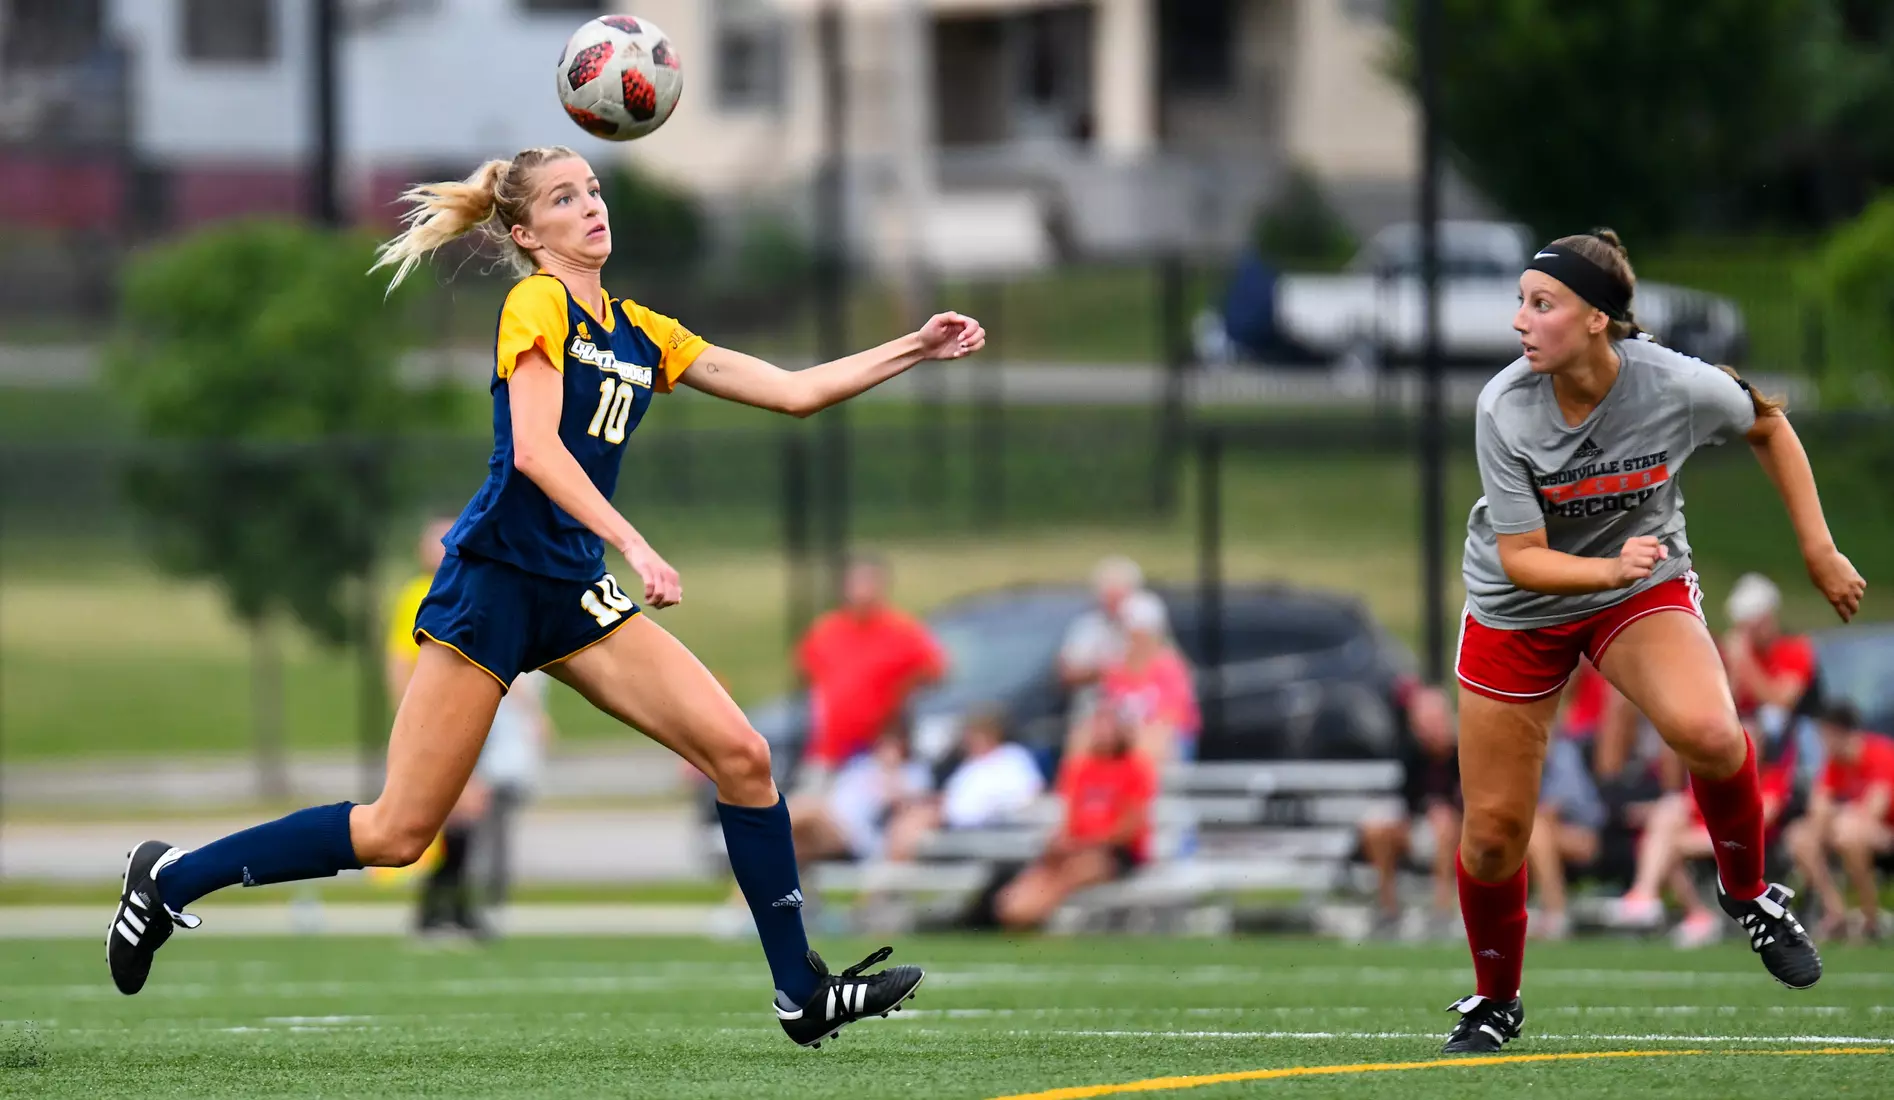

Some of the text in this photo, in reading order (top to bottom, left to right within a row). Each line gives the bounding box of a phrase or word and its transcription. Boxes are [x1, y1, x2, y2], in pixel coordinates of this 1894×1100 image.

[587, 377, 634, 445] 10
[1623, 450, 1669, 473] STATE
[580, 573, 634, 628] 10
